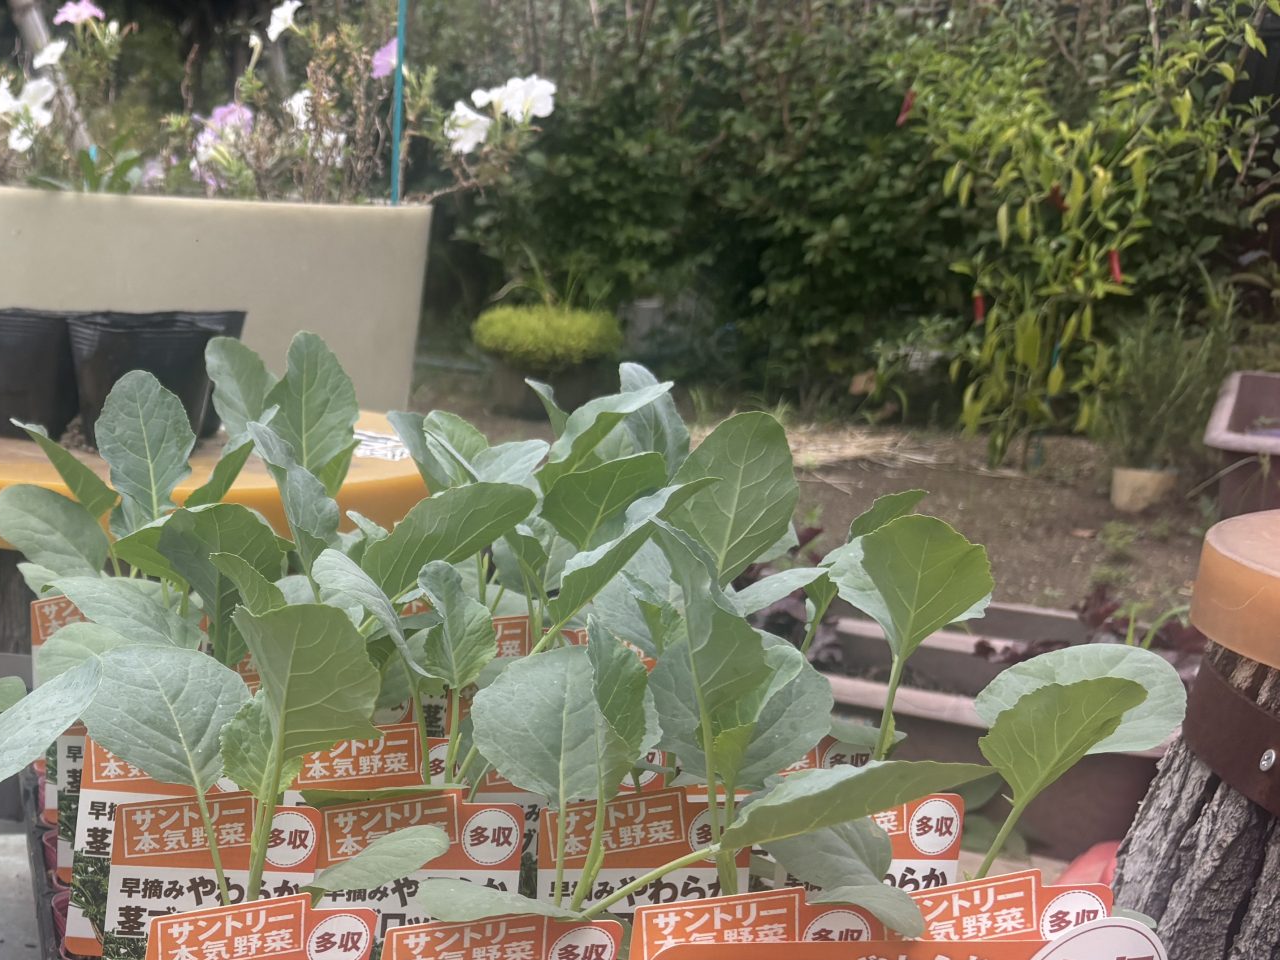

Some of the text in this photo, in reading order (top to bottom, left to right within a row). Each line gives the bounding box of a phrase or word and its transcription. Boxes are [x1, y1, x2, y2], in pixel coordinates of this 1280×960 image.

[305, 752, 409, 779] 本気野菜
[132, 802, 246, 832] サントリー
[335, 802, 448, 834] サントリー
[916, 816, 954, 837] 多収
[132, 822, 247, 853] 本気野菜
[268, 828, 310, 850] 多収
[470, 827, 513, 847] 多収
[918, 886, 1025, 922] ントリー
[168, 910, 294, 945] サントリー
[653, 903, 788, 936] サントリー
[903, 907, 1025, 941] 気野菜
[1049, 909, 1100, 934] 多収
[315, 931, 363, 953] 多収
[404, 922, 536, 955] サントリー
